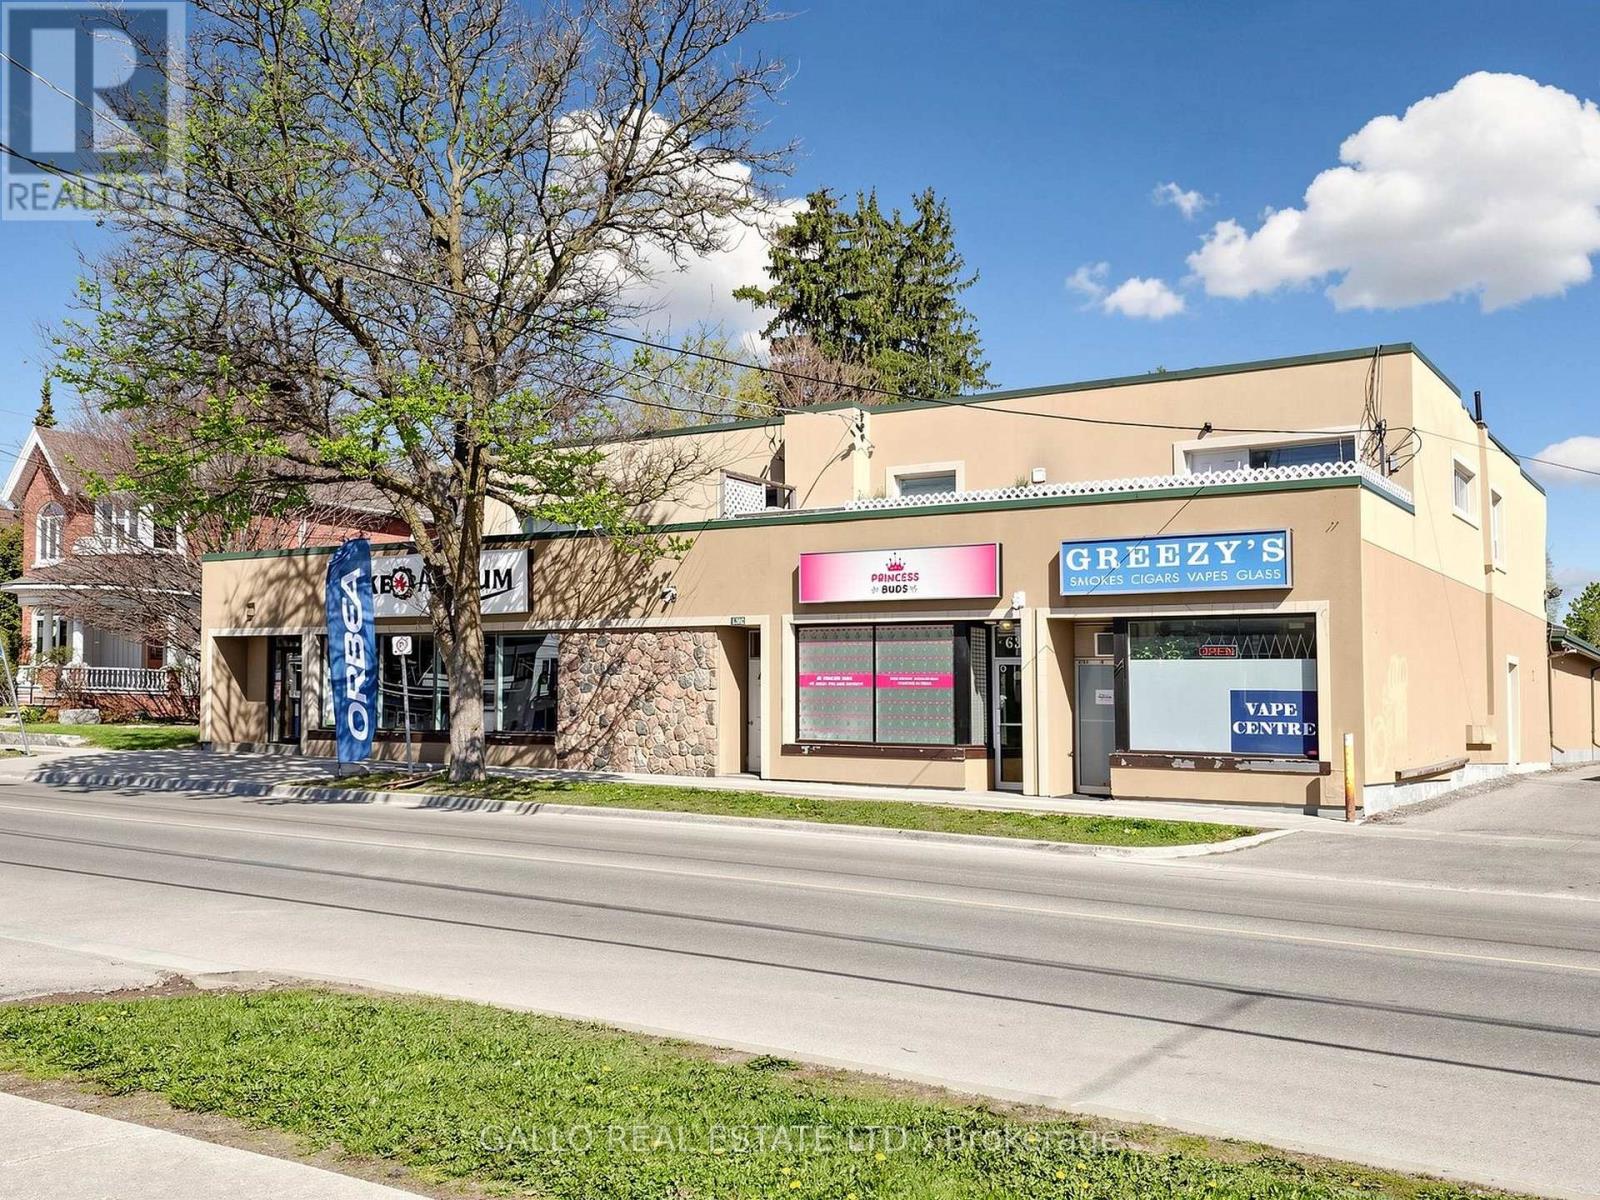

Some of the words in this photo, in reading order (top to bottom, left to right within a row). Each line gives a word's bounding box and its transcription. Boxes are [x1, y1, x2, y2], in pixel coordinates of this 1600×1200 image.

[1066, 538, 1285, 571] GREEZY'S
[871, 572, 920, 583] PRINCESS
[1070, 575, 1124, 587] SMOKES
[1131, 572, 1180, 585] CIGARS
[1187, 570, 1228, 582] VAPES
[1236, 569, 1281, 580] GLASS
[881, 584, 908, 594] BUDS
[340, 567, 369, 742] ORBEA
[1245, 702, 1298, 717] VAPE
[1232, 721, 1317, 736] CENTRE
